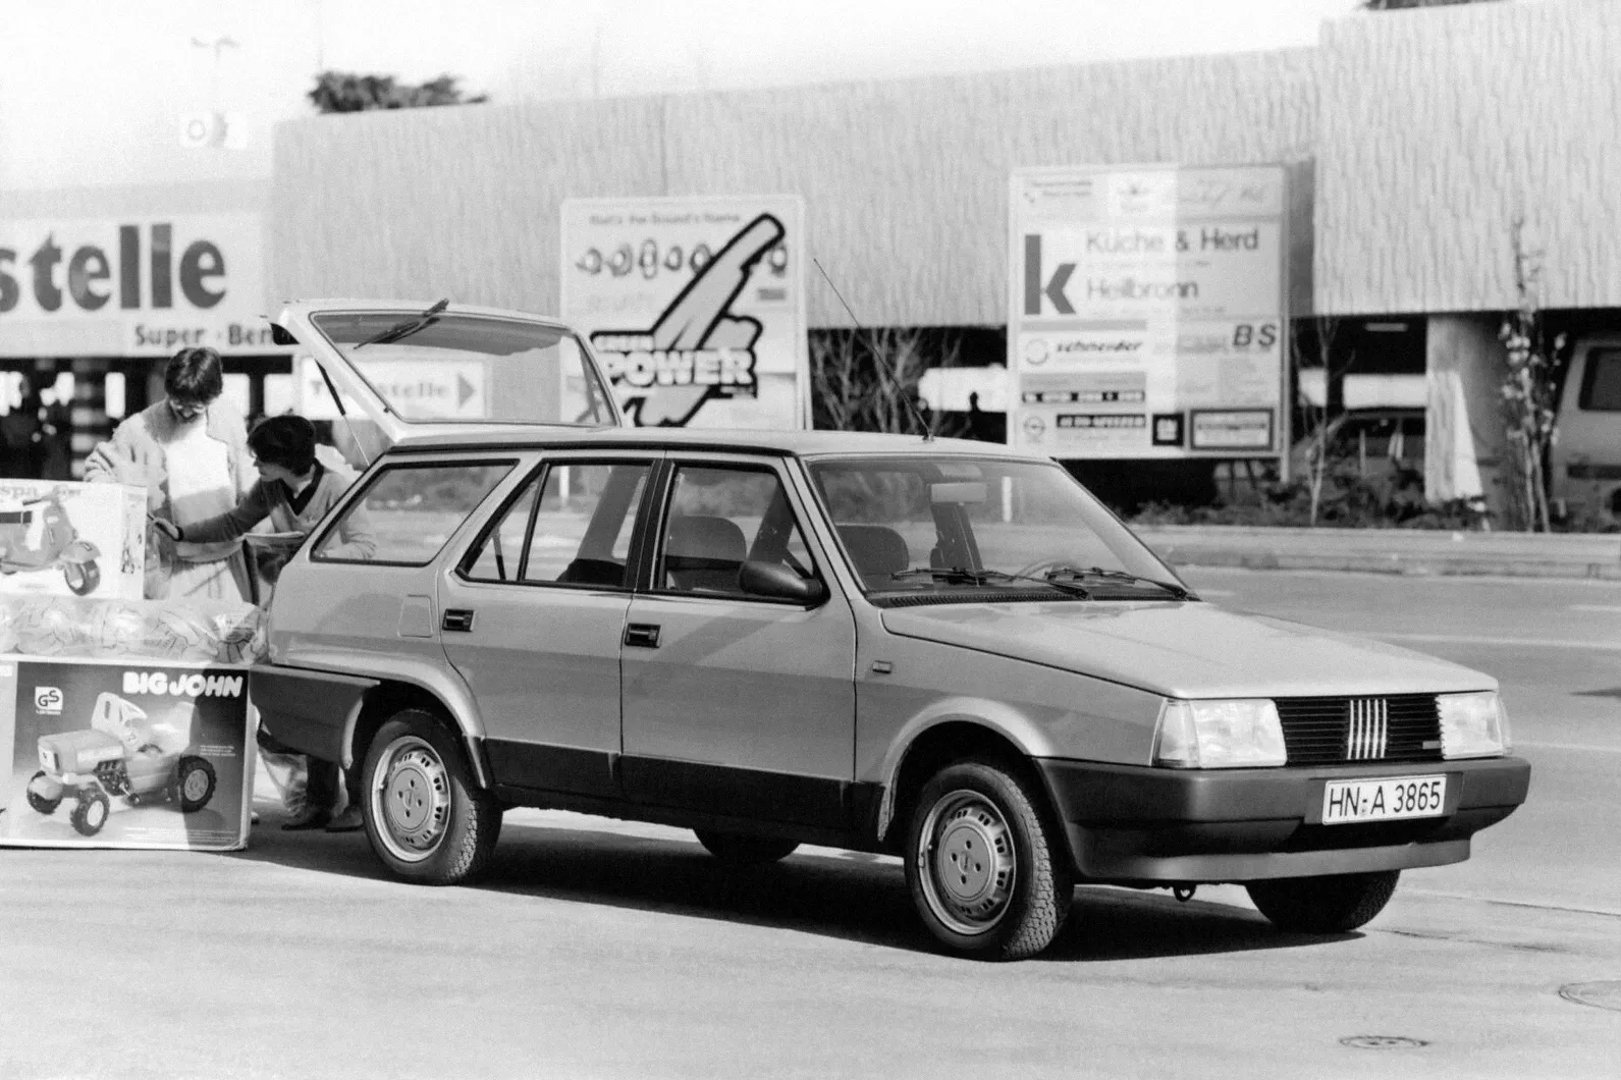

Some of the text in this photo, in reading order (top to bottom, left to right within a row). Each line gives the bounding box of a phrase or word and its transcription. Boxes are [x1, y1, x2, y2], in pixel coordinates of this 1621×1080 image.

[1176, 230, 1189, 251] &
[135, 323, 205, 347] Super
[598, 349, 752, 388] POWER
[122, 671, 243, 698] BIG JOHN
[38, 690, 60, 707] GS
[1393, 781, 1441, 813] 3865
